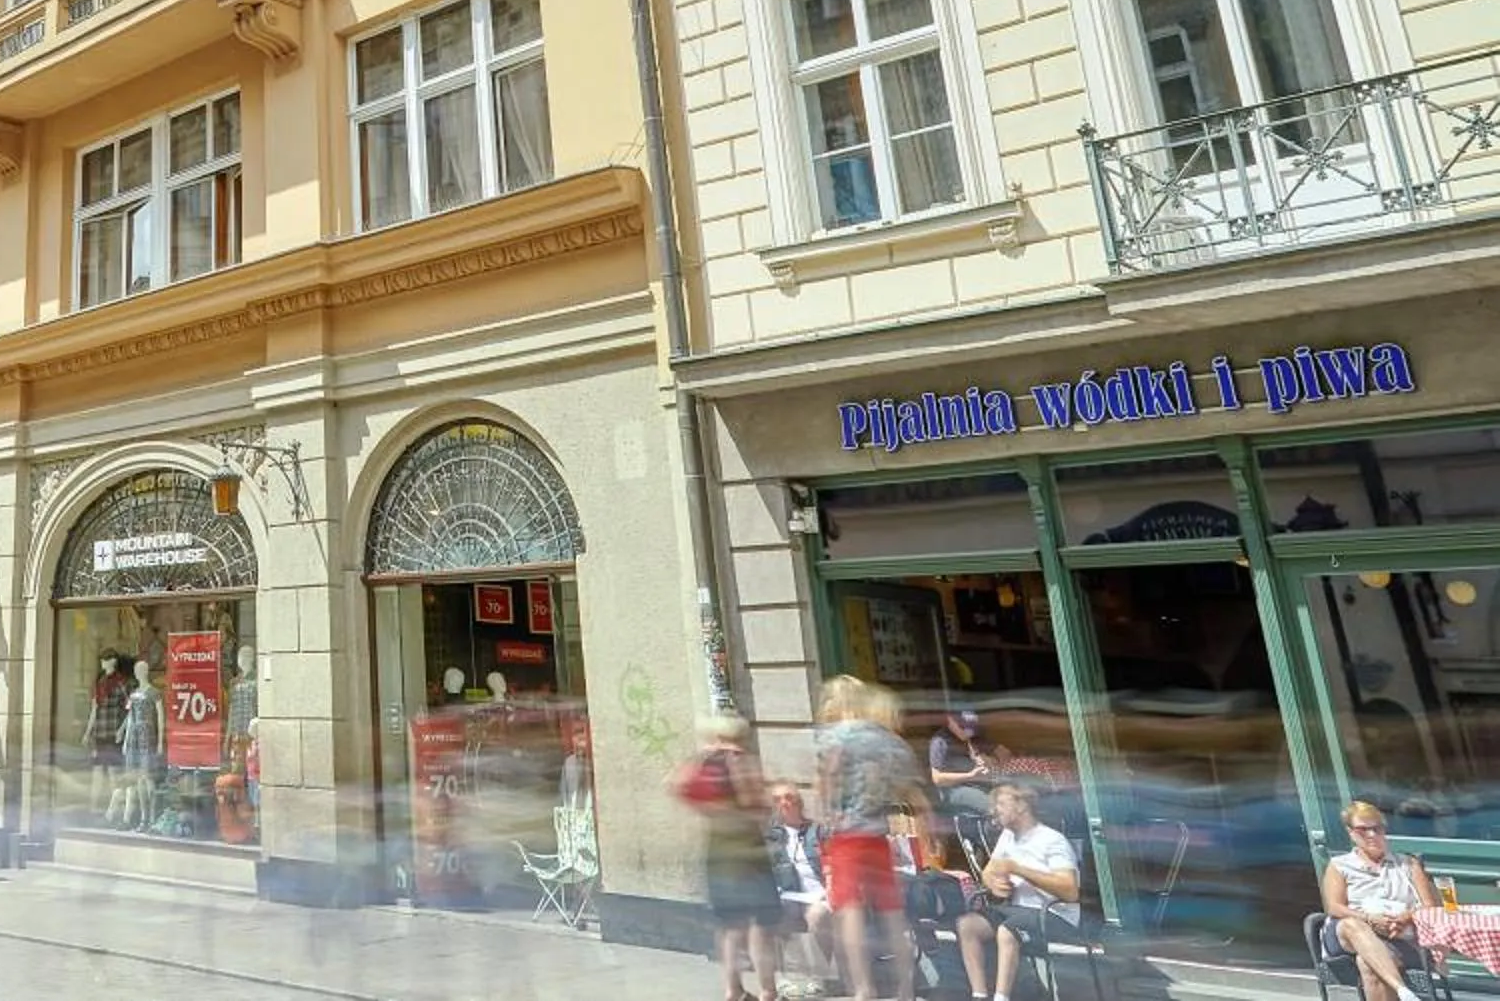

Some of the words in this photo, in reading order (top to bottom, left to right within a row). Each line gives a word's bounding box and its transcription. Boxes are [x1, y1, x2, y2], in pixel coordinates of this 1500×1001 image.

[838, 386, 1017, 452] Pijalnia
[1030, 361, 1195, 431] wódki
[1211, 356, 1242, 412] i
[1257, 341, 1415, 414] piwa
[115, 532, 194, 552] MOUNTAIN
[115, 547, 208, 571] WAREHOUSE
